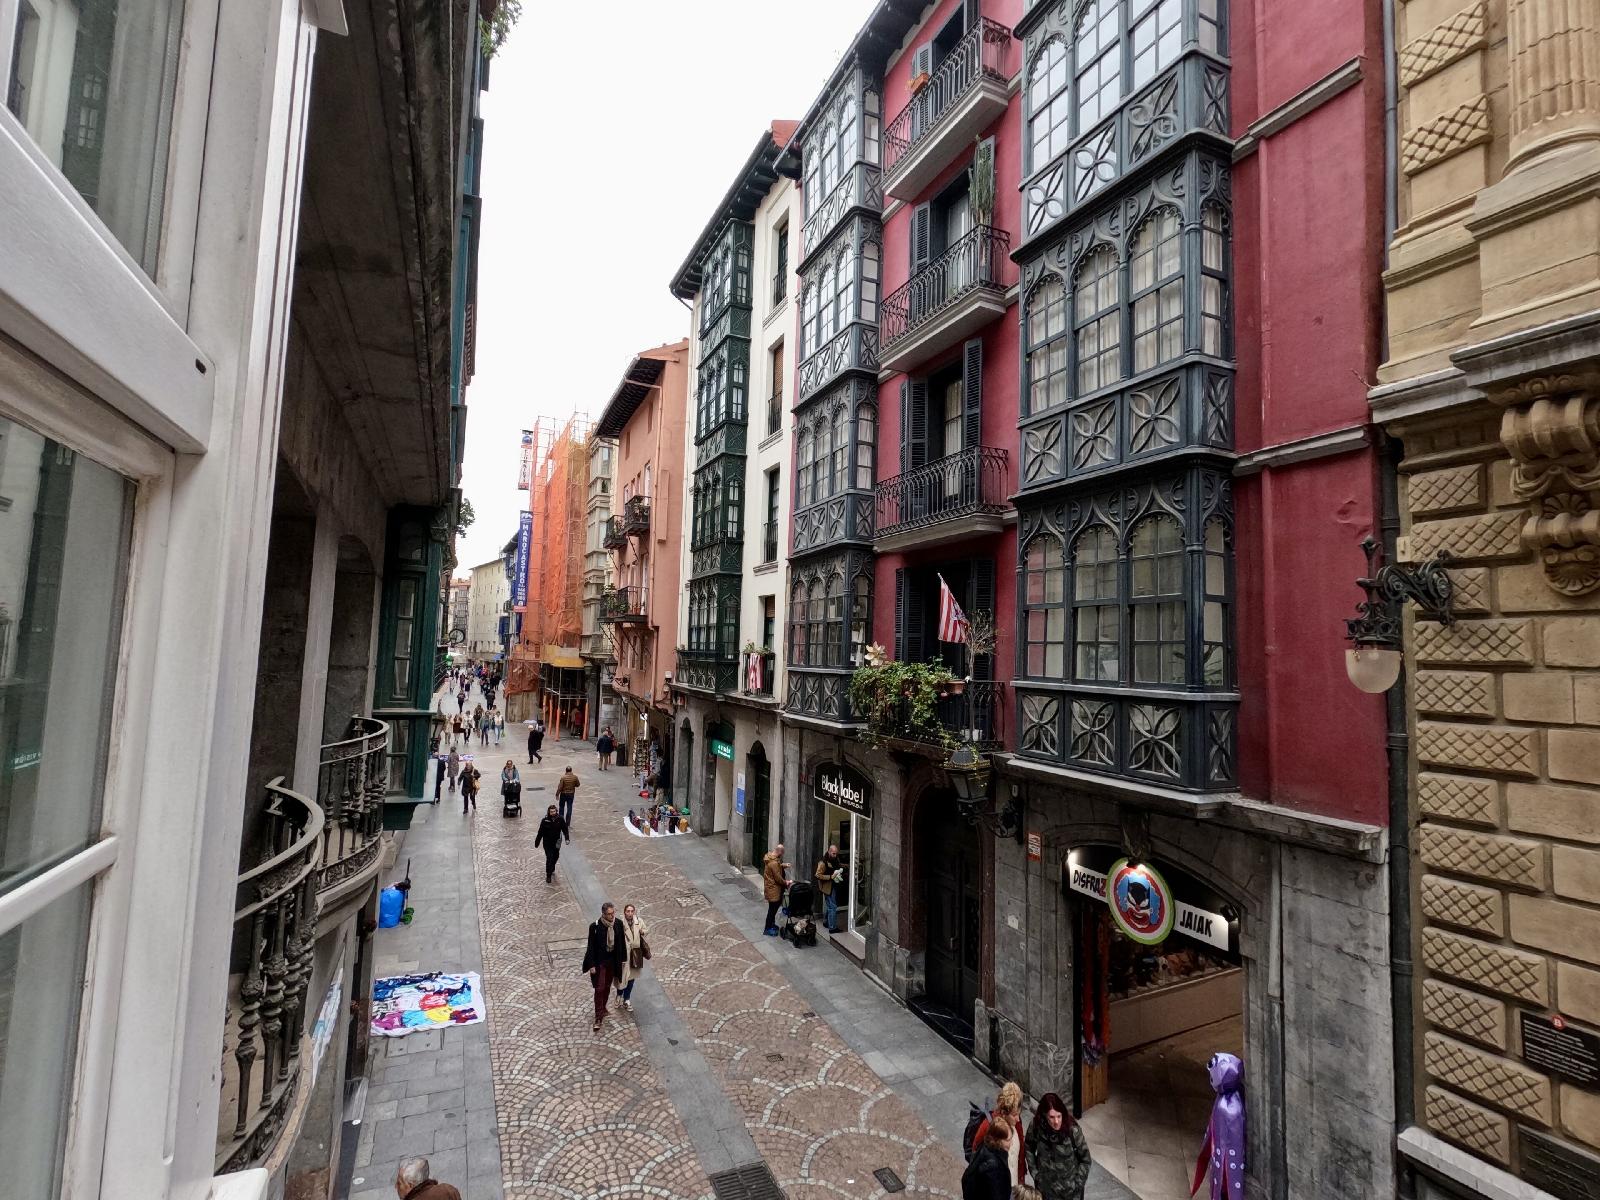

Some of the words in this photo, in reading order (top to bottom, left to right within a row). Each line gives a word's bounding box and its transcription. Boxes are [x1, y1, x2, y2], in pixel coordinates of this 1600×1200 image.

[821, 774, 839, 794] Black
[840, 780, 864, 804] label
[1073, 869, 1107, 897] DISFRAZ
[1180, 909, 1213, 937] JAIAK
